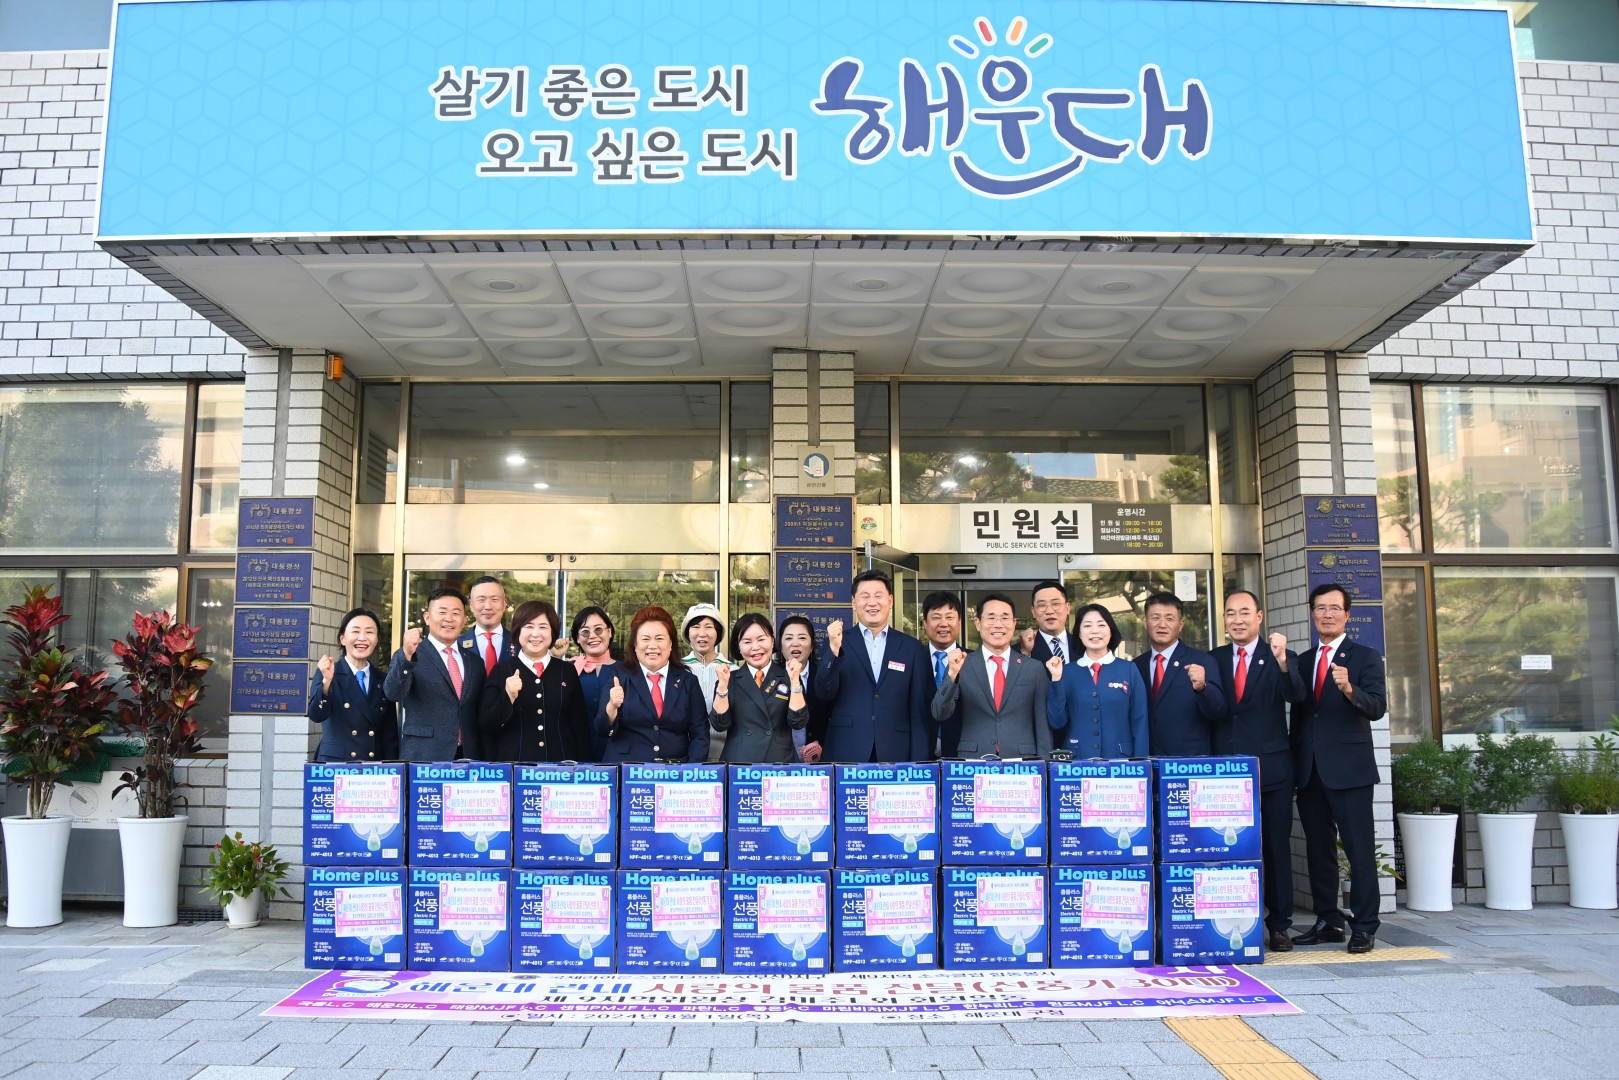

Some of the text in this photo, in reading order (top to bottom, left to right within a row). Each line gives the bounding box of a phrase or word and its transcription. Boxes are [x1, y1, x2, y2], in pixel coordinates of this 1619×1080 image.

[434, 69, 742, 116] 살기 좋은 도시
[481, 132, 792, 179] 오고 싶은 도시
[1117, 508, 1146, 516] 운영시간
[311, 766, 362, 778] Home
[417, 767, 504, 782] Home plus
[630, 767, 718, 782] Home plus
[738, 768, 788, 780] Home
[844, 767, 932, 782] Home plus
[950, 764, 1039, 776] Home plus
[1058, 764, 1145, 778] Home plus
[1165, 761, 1249, 775] Home plus
[522, 769, 610, 784] Home plus
[313, 870, 398, 884] Home plus
[414, 870, 500, 882] Home plus
[520, 873, 608, 885] Home plus
[732, 874, 822, 885] Home plus
[840, 871, 929, 885] Home plus
[1059, 868, 1146, 880] Home plus
[410, 982, 536, 993] 해운대
[550, 983, 632, 994] 관내
[642, 983, 771, 995] 사랑의
[789, 983, 868, 995] 물품
[884, 980, 1116, 995] 전달(선풍기
[910, 994, 1026, 1003] 회원일동
